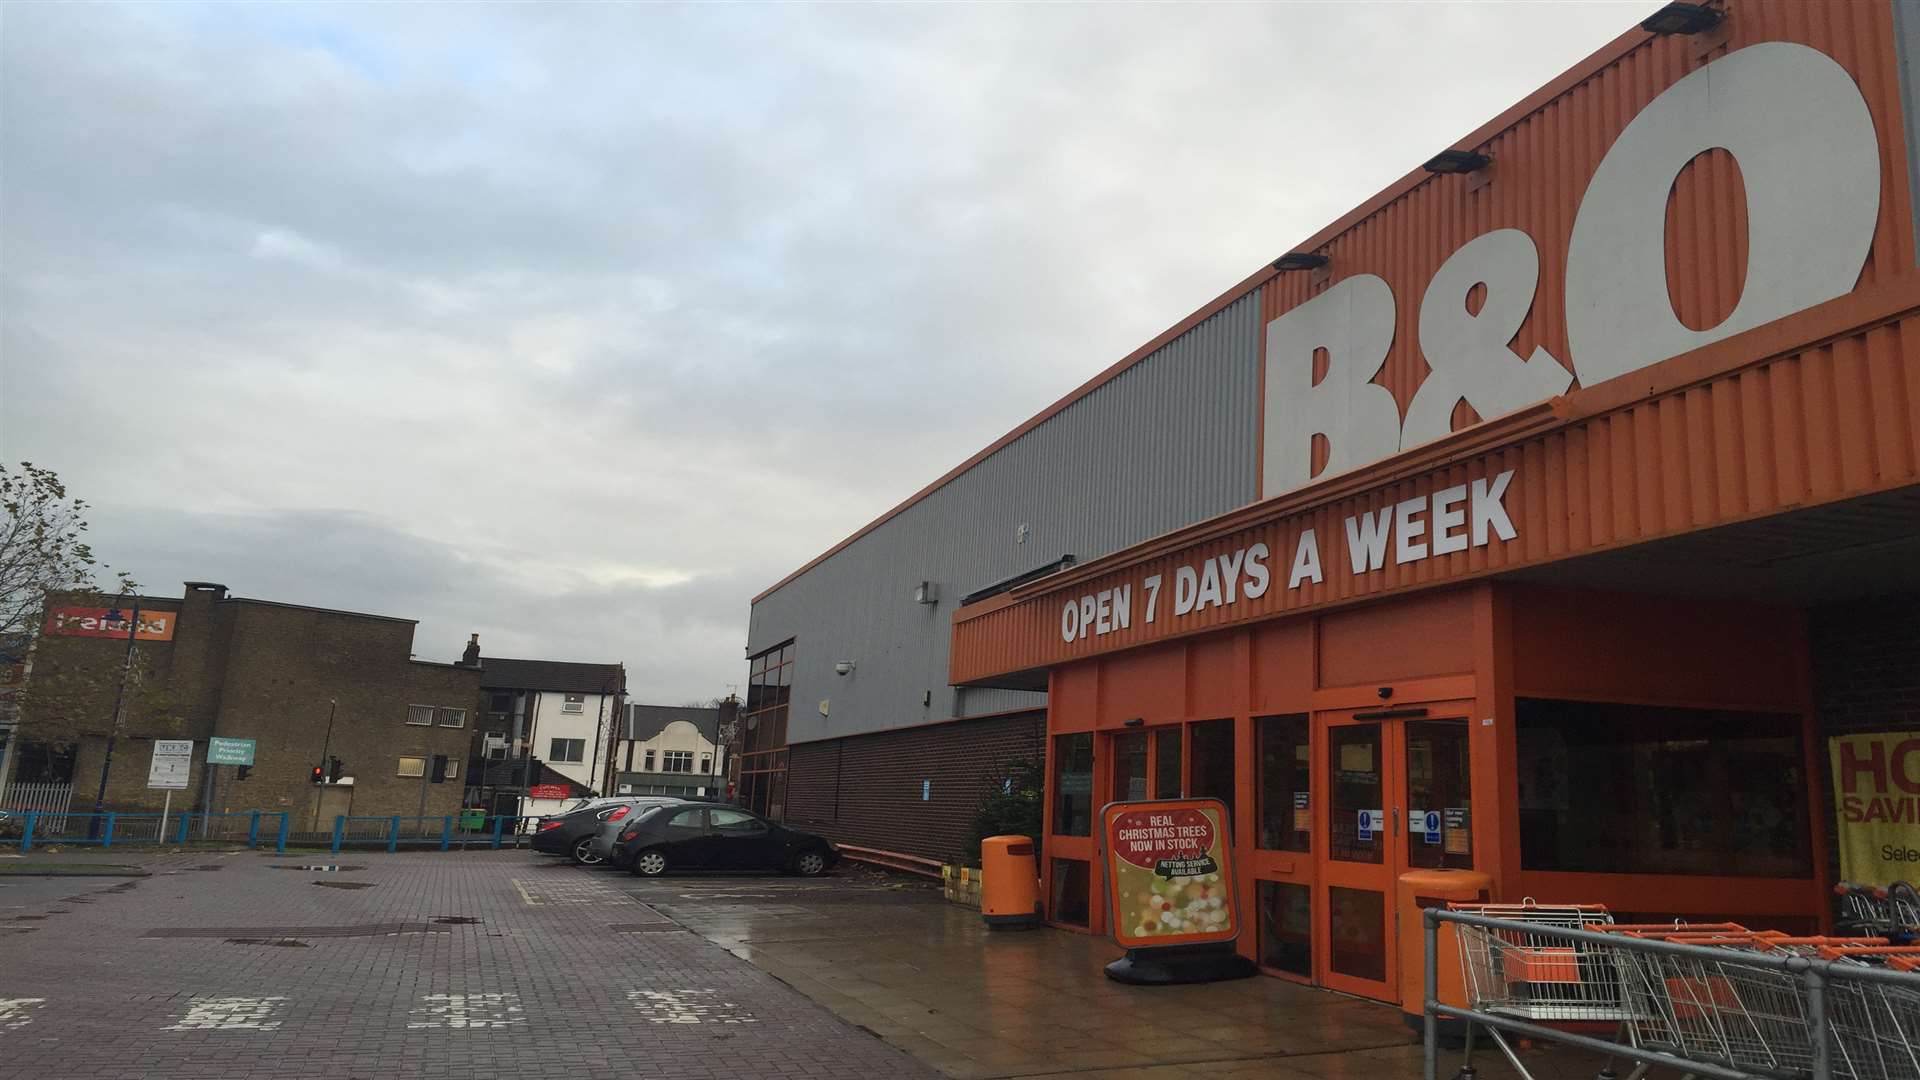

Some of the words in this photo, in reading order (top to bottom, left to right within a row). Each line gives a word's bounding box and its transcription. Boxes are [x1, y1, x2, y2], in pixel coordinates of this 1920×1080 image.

[1062, 584, 1131, 643] OPEN
[1144, 575, 1162, 623] 7
[1174, 543, 1270, 617] DAYS
[1288, 528, 1323, 589] A
[1345, 469, 1518, 575] WEEK
[214, 740, 252, 749] Pedestrian
[218, 747, 245, 756] Priority
[215, 753, 247, 763] Walkway
[1843, 796, 1920, 824] SAVI
[1150, 815, 1175, 826] REAL
[1119, 827, 1175, 840] CHRISTMAS
[1177, 825, 1207, 837] TREES
[1130, 841, 1154, 852] NOW
[1155, 840, 1165, 850] IN
[1167, 838, 1198, 850] STOCK
[1881, 844, 1920, 862] Sele
[1160, 860, 1185, 868] NETTING
[1186, 858, 1210, 867] SERVICE
[1170, 866, 1202, 875] AVAILABLE
